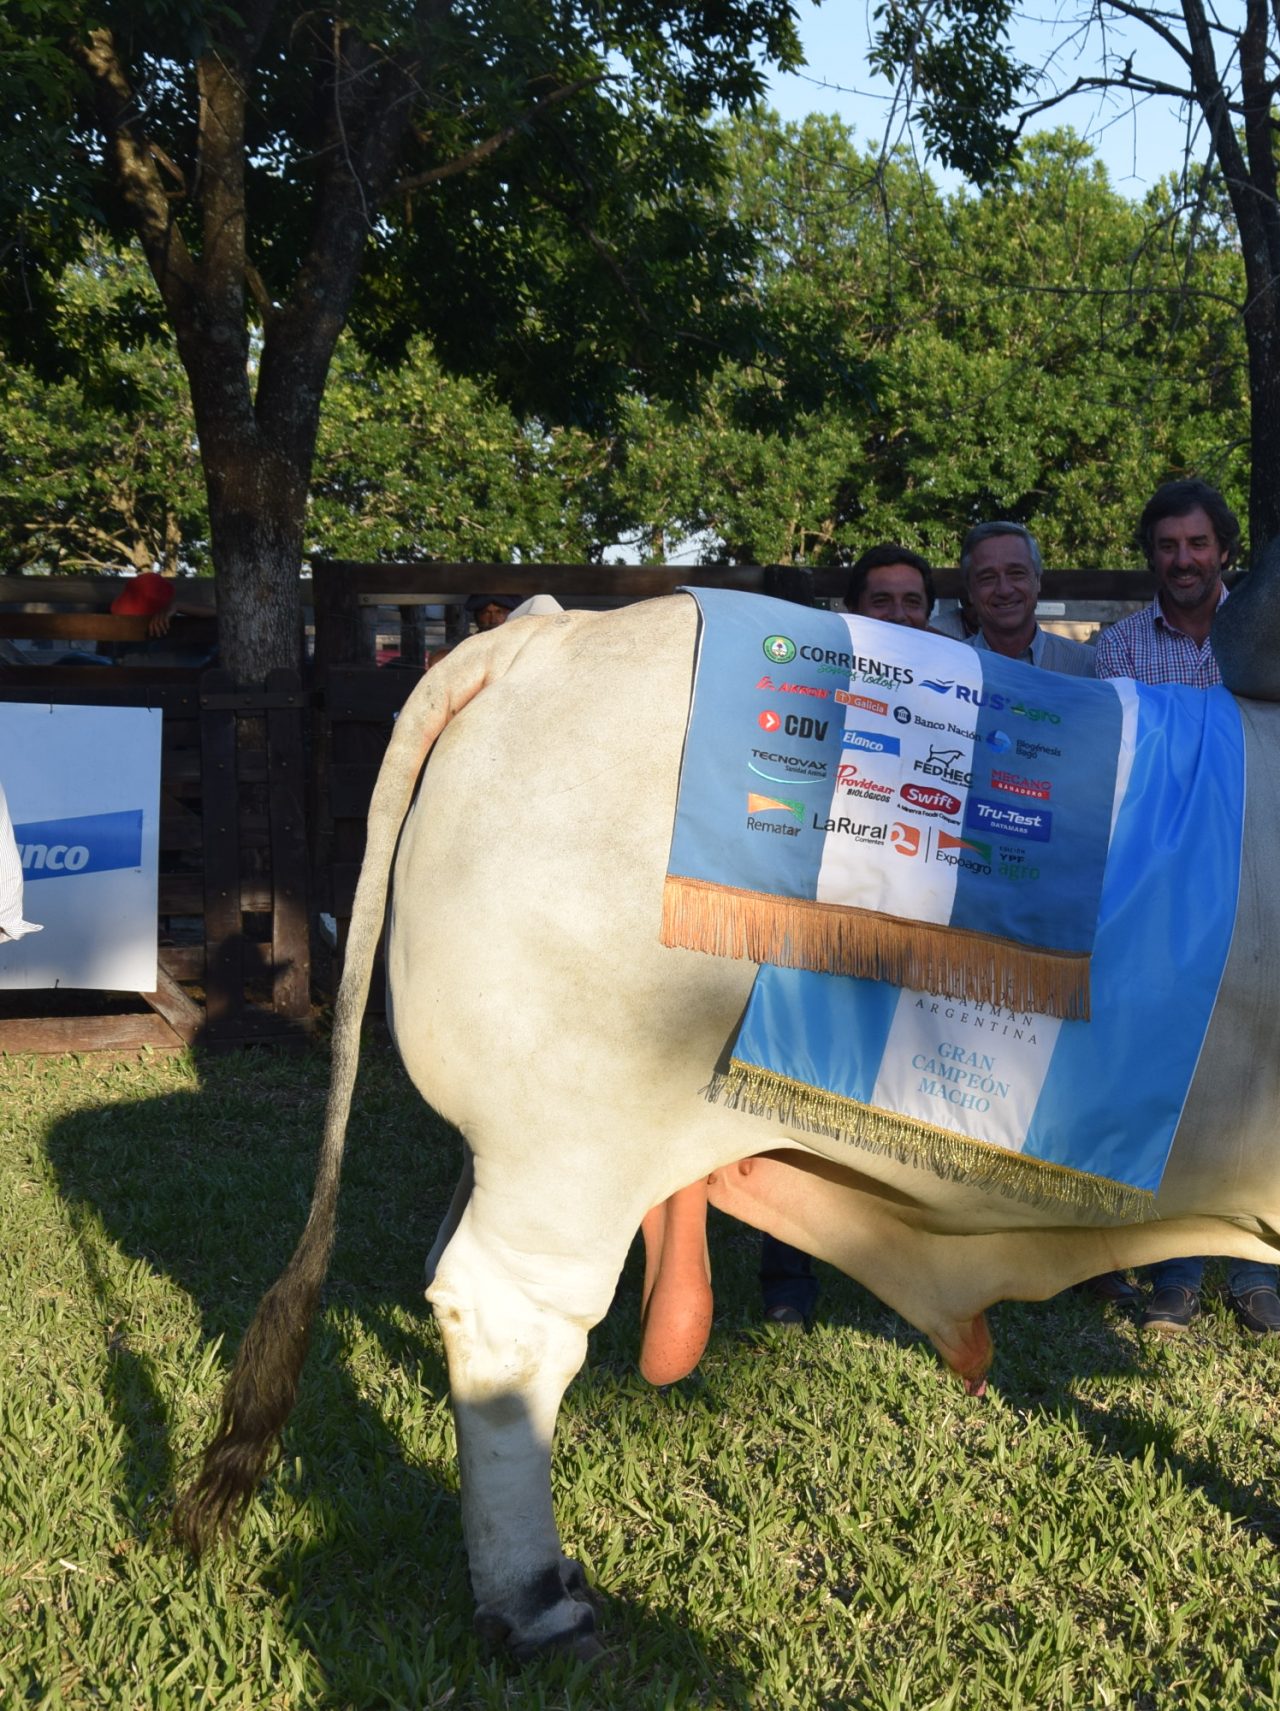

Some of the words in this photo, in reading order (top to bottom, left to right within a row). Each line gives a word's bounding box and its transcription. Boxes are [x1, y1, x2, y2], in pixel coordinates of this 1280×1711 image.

[799, 645, 914, 684] CORRIENTES
[854, 698, 885, 714] Galicia
[955, 684, 1006, 711] RUS
[784, 713, 829, 742] CDV
[914, 714, 946, 731] Banco
[947, 722, 982, 743] Nación
[843, 731, 884, 752] Elanco
[751, 748, 828, 770] TECNOVAX
[834, 764, 895, 794] Providean
[991, 768, 1053, 791] MECANO
[997, 782, 1043, 798] GANADERO
[846, 787, 891, 803] BIOLÓGICOS
[906, 788, 955, 810] Swift
[746, 816, 802, 837] Rematar
[812, 812, 888, 840] LaRural
[977, 804, 1042, 827] Tru-Test
[990, 821, 1028, 834] DATAMARS
[854, 836, 885, 846] Corrientes
[935, 850, 992, 876] Expoagro
[1000, 853, 1025, 864] YPF
[997, 862, 1041, 881] agro
[915, 998, 1037, 1045] ARGENTINA
[937, 1041, 996, 1071] GRAN
[911, 1053, 1011, 1099] CAMPEÓN
[917, 1077, 991, 1113] MACHO
